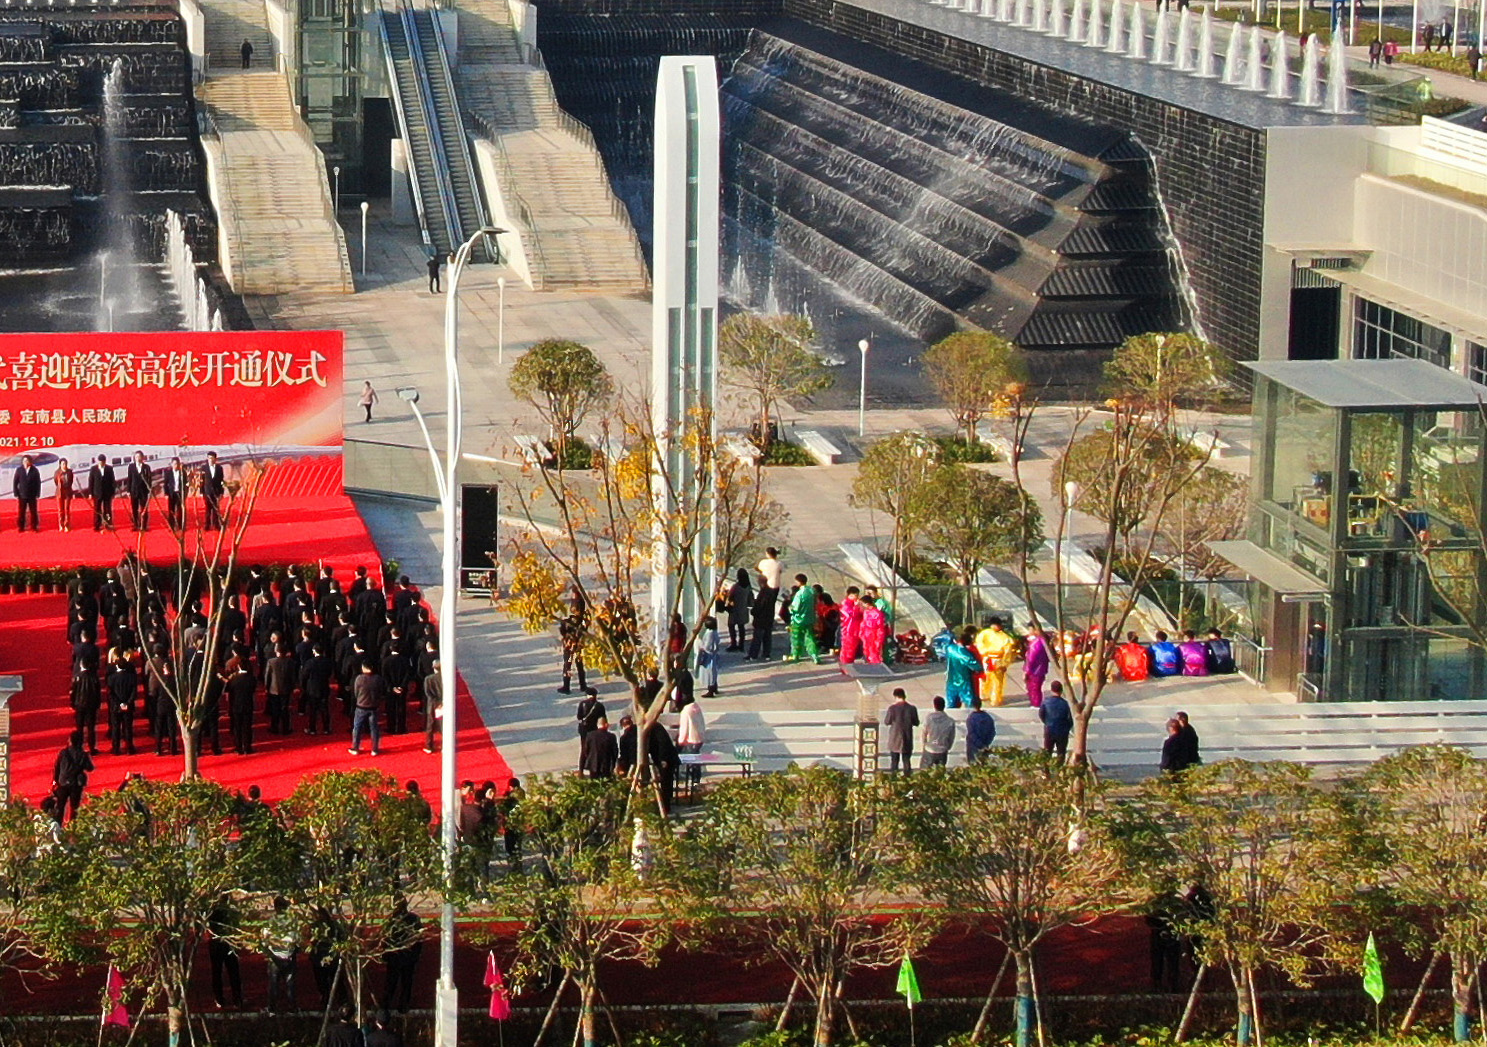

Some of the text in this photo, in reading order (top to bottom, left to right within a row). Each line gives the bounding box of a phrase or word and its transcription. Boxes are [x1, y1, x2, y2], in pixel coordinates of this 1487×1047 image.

[20, 408, 127, 424] 定南县人民政府
